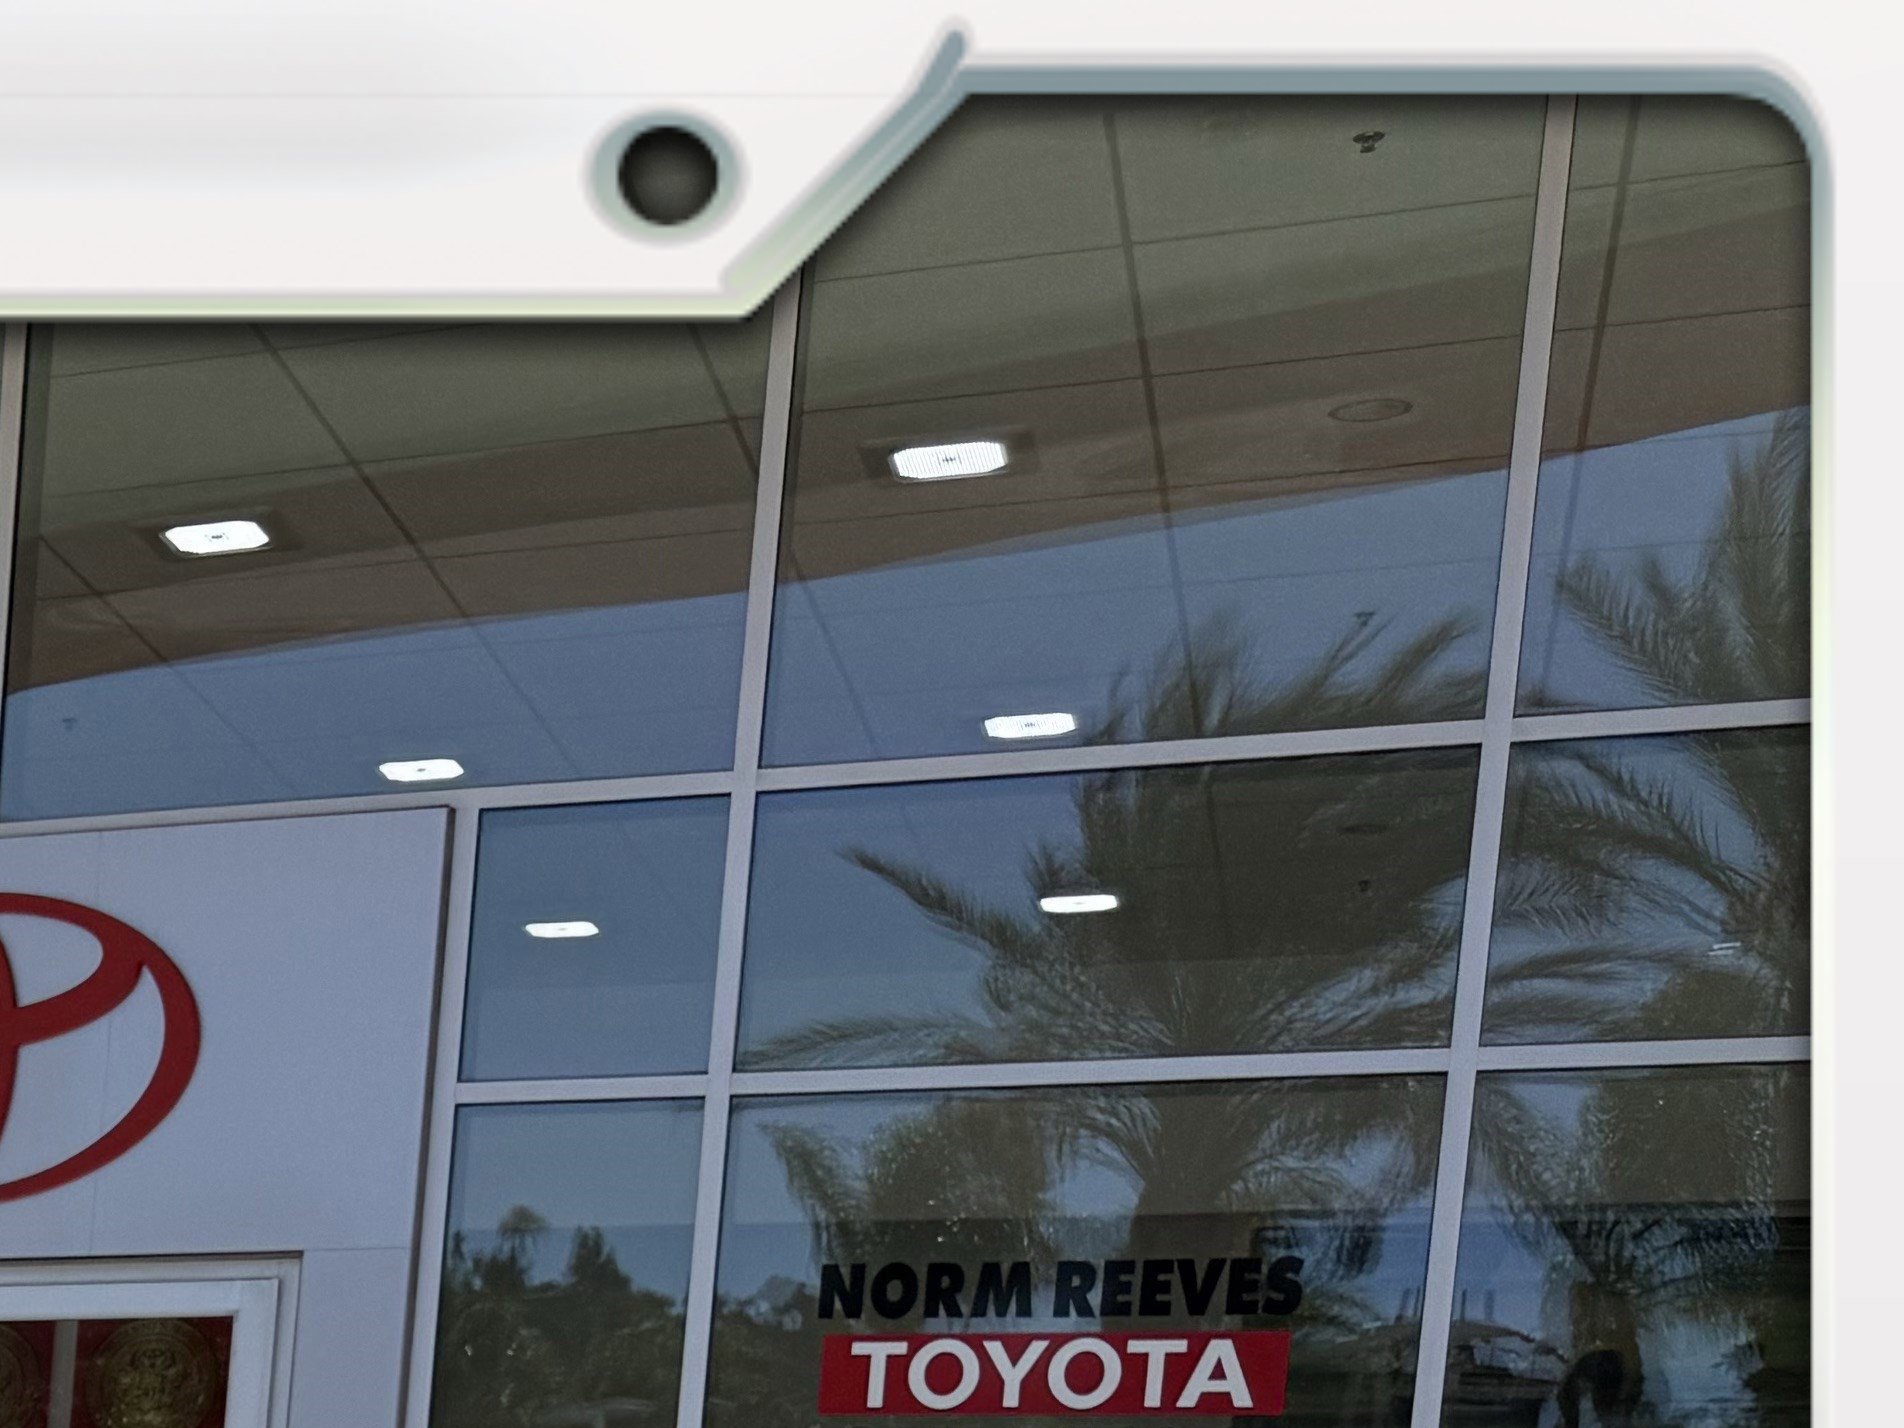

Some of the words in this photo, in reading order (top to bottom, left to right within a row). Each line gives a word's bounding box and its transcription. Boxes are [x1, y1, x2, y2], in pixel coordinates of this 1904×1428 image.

[817, 1260, 1032, 1319] NORM
[1052, 1255, 1305, 1318] REEVES
[850, 1337, 1254, 1411] TOYOTA
